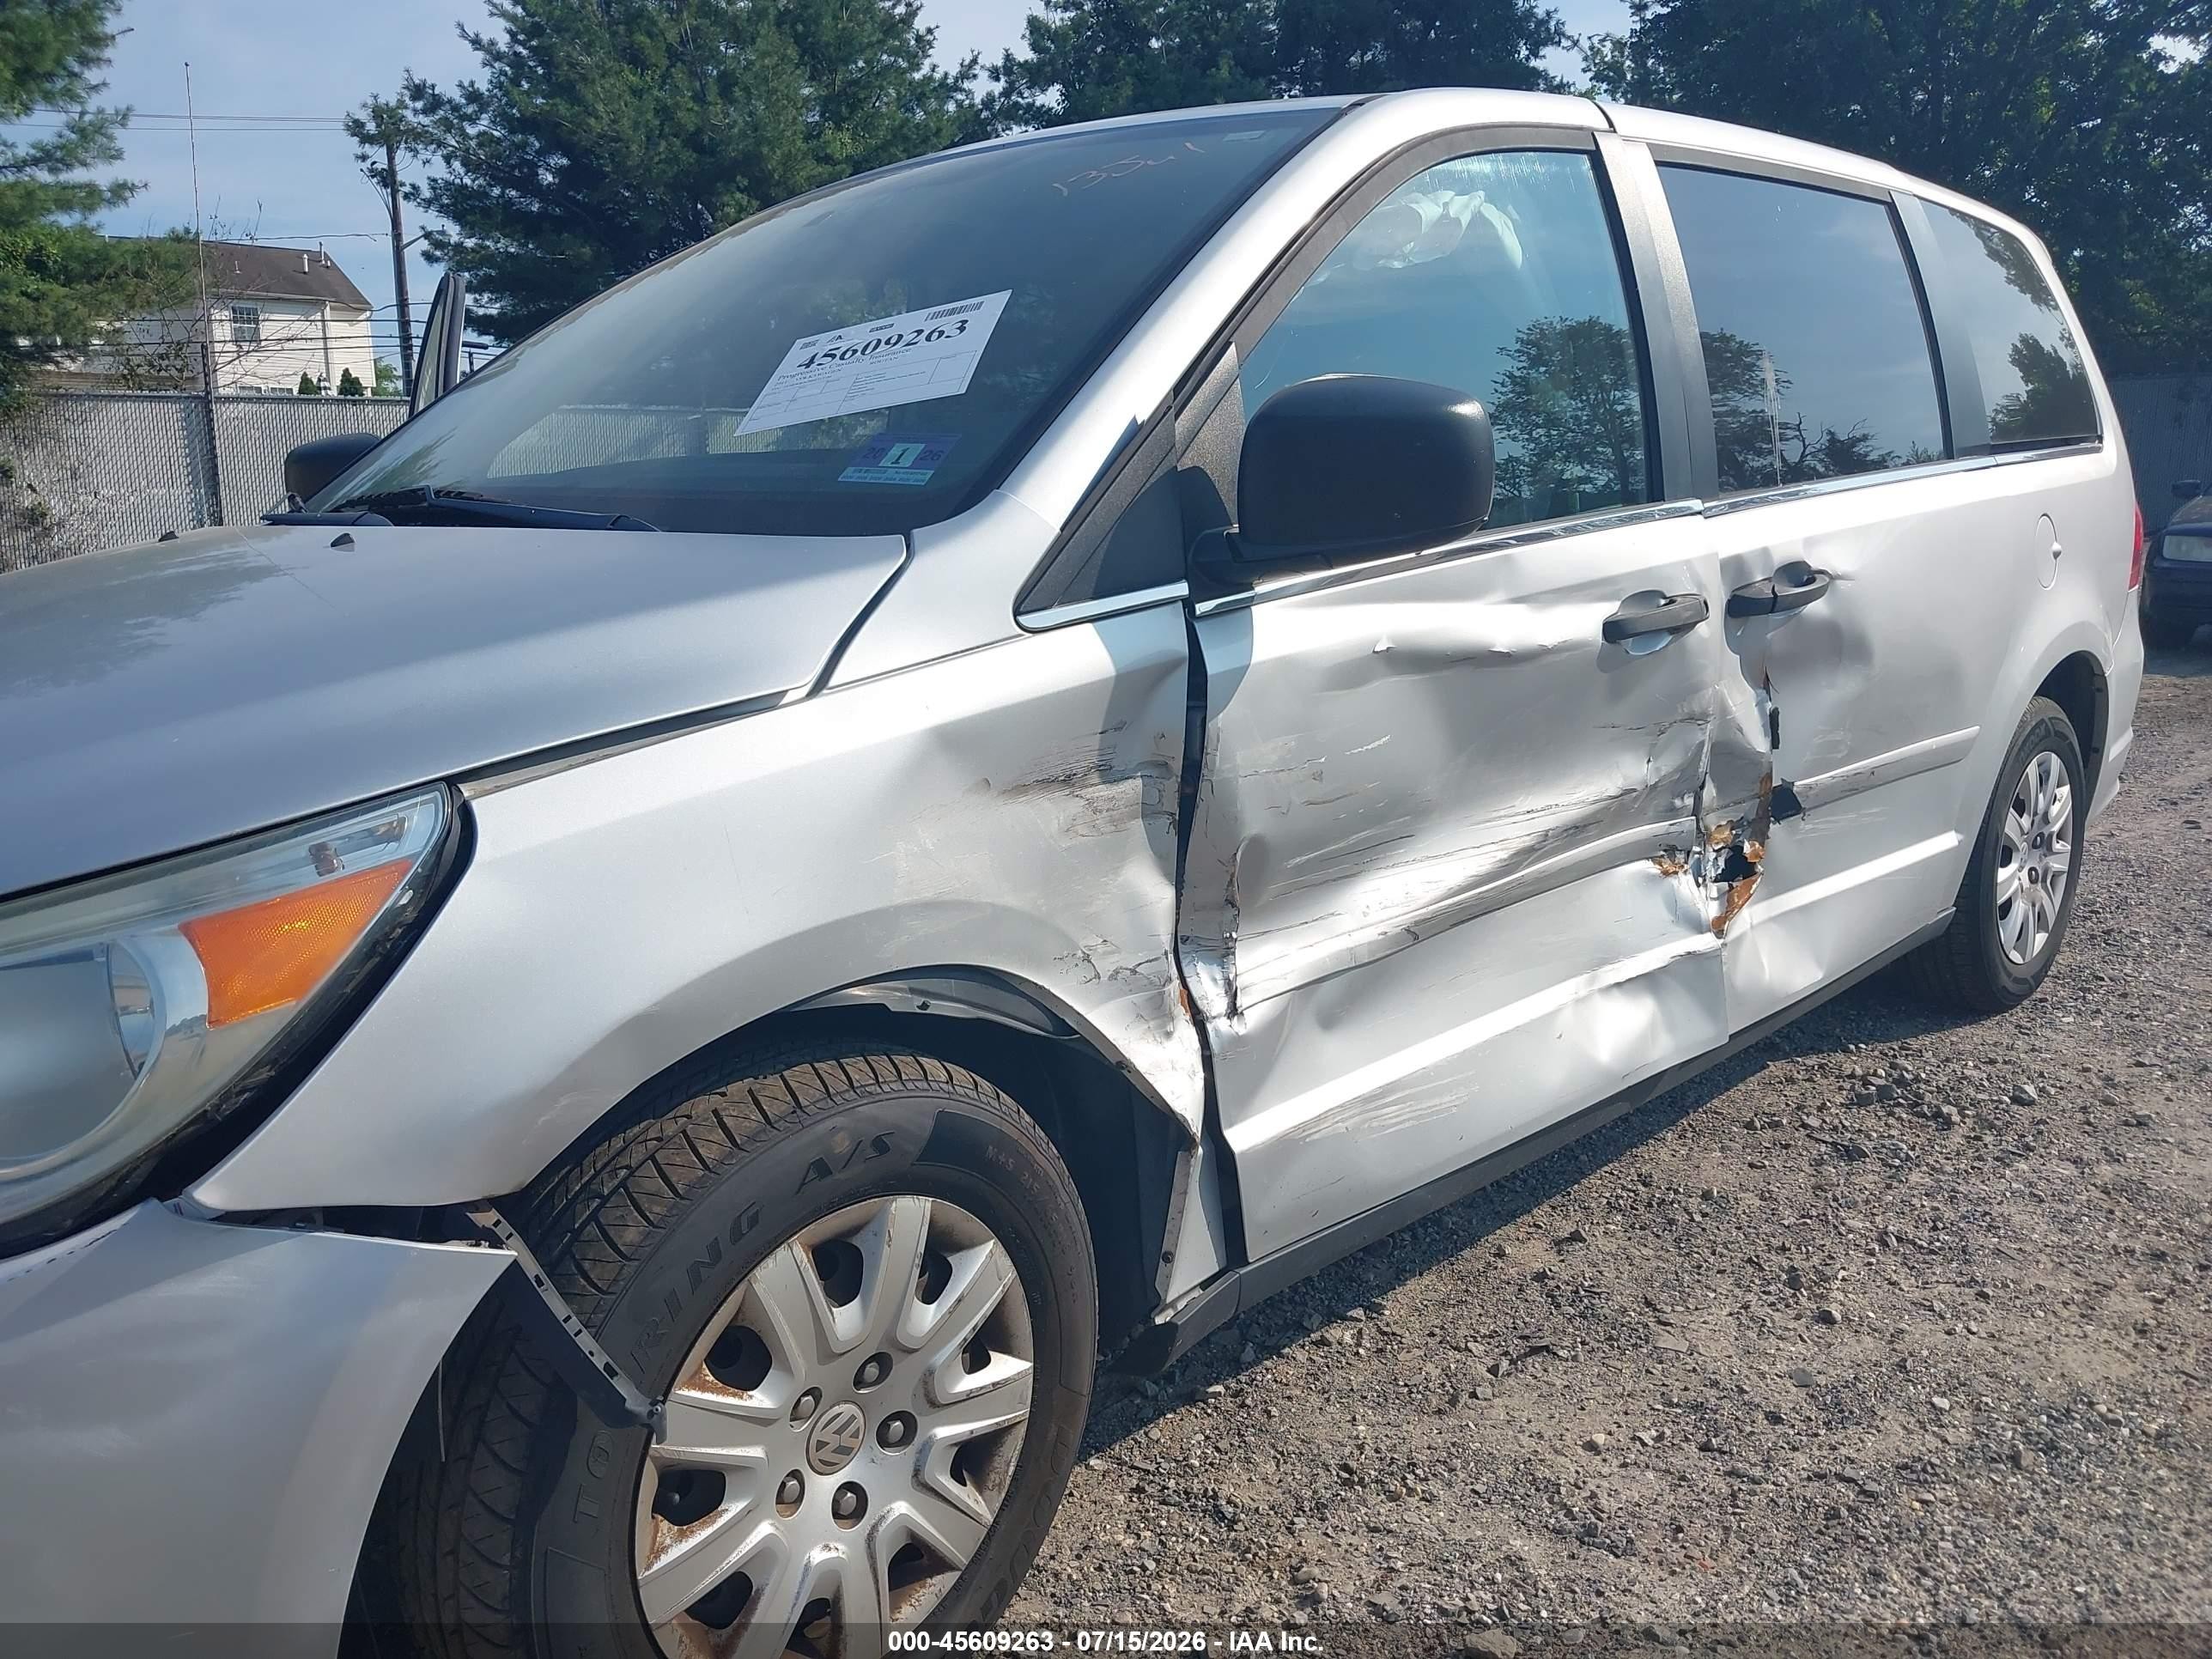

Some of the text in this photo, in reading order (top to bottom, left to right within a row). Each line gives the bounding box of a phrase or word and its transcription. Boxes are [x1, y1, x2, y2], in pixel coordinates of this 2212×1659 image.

[796, 319, 969, 369] 45609263
[868, 348, 913, 361] Insurance
[890, 447, 910, 465] 1
[795, 1129, 896, 1198] A/S
